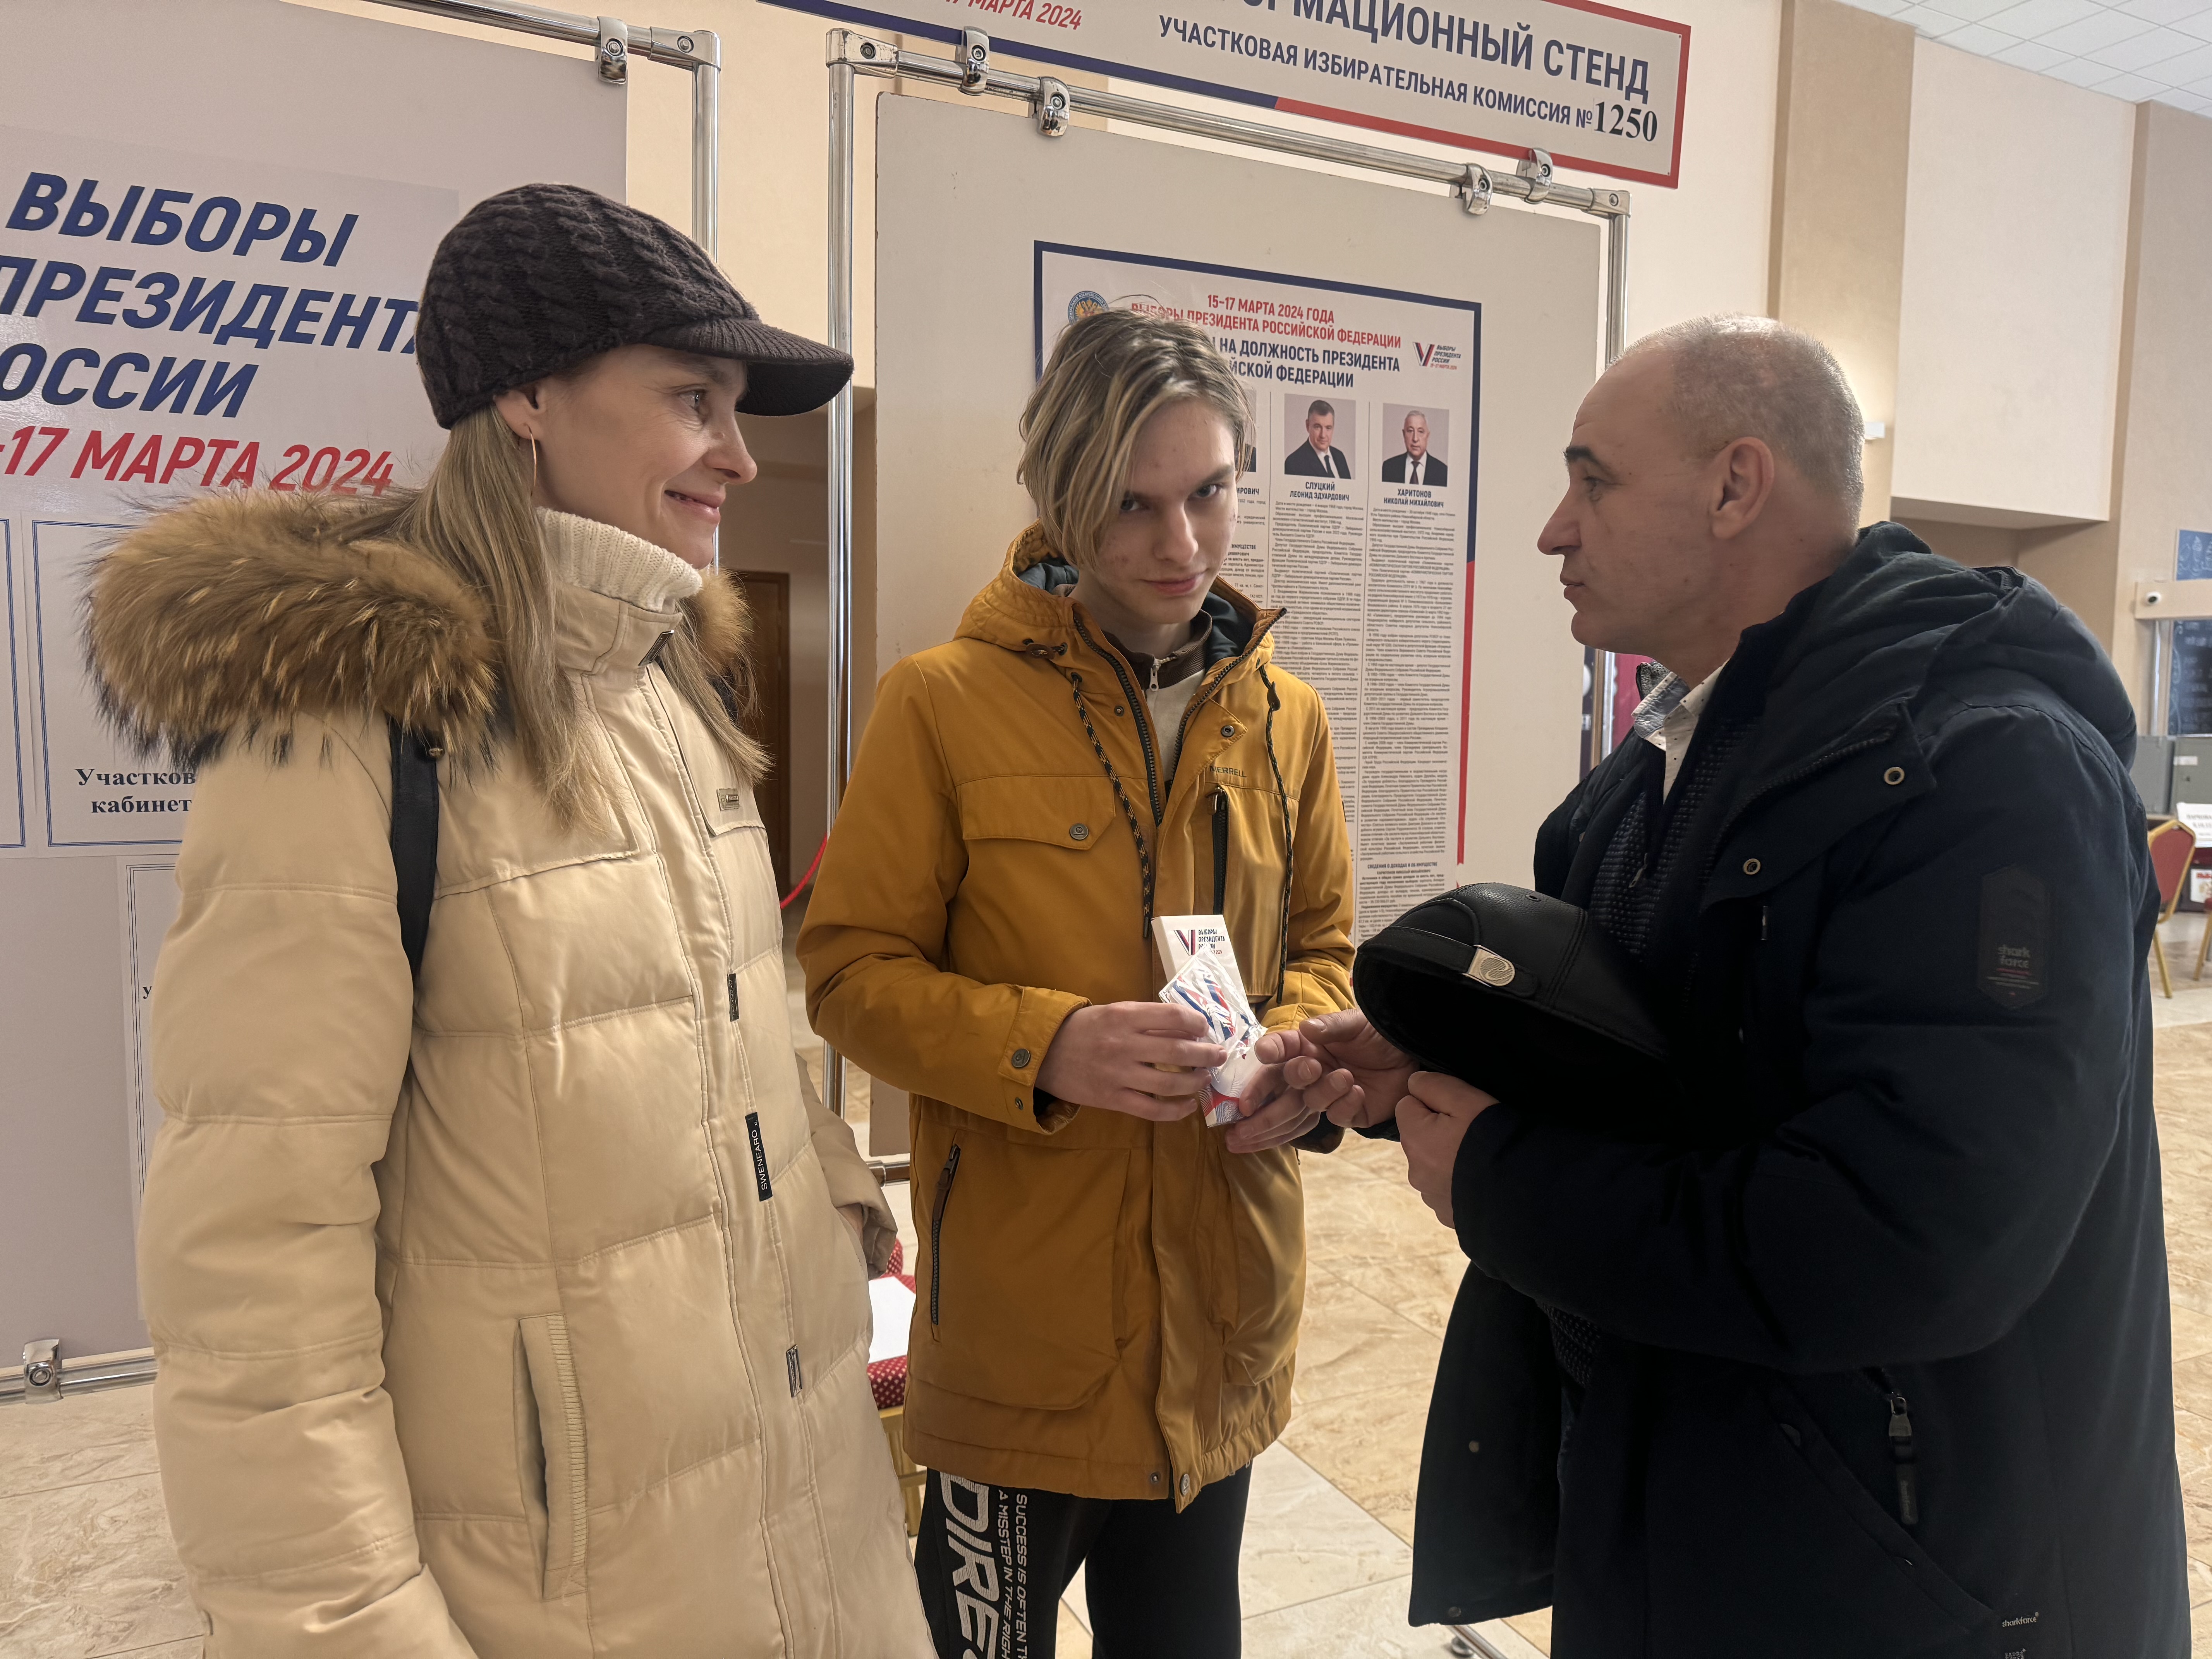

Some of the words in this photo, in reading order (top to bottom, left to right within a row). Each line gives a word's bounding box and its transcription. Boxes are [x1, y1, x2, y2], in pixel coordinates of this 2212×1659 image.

[1036, 3, 1082, 30] 2024
[1159, 15, 1297, 66] УЧАСТКОВАЯ
[1304, 48, 1467, 103] ИЗБИРАТЕЛЬНАЯ
[1473, 86, 1570, 125] КОМИССИЯ
[1543, 40, 1649, 105] СТЕНД
[6, 172, 359, 267] ВЫБОРЫ
[1238, 298, 1275, 316] МАРТА
[1278, 304, 1303, 319] 2024
[1306, 307, 1334, 325] ГОДА
[1187, 310, 1259, 332] ПРЕЗИДЕНТА
[1262, 320, 1334, 341] РОССИЙСКОЙ
[1337, 328, 1401, 349] ФЕДЕРАЦИИ
[1220, 337, 1237, 354] НА
[1239, 340, 1319, 363] ДОЛЖНОСТЬ
[1322, 349, 1400, 372] ПРЕЗИДЕНТА
[1276, 364, 1353, 388] ФЕДЕРАЦИИ
[71, 430, 260, 489] МАРТА
[269, 444, 394, 496] 2024
[1290, 491, 1313, 499] ЛЕОНИД
[1314, 492, 1349, 501] ЭДУАРДОВИЧ
[1305, 481, 1335, 491] СЛУЦКИЙ
[1398, 489, 1432, 498] ХАРИТОНОВ
[1384, 497, 1408, 506] НИКОЛАЙ
[1409, 499, 1444, 508] МИХАЙЛОВИЧ
[74, 768, 196, 785] Участков
[91, 795, 192, 813] кабинет
[751, 1130, 768, 1190] SWENEARO
[998, 1489, 1008, 1500] A
[998, 1504, 1012, 1566] MISSTEP
[1016, 1493, 1027, 1567] SUCCESS
[939, 1471, 1000, 1659] DIRE
[1003, 1566, 1013, 1583] IN
[1017, 1568, 1026, 1585] IS
[1004, 1586, 1013, 1621] THE
[1016, 1586, 1027, 1642] OFTEN
[2002, 1616, 2037, 1627] sharkforce
